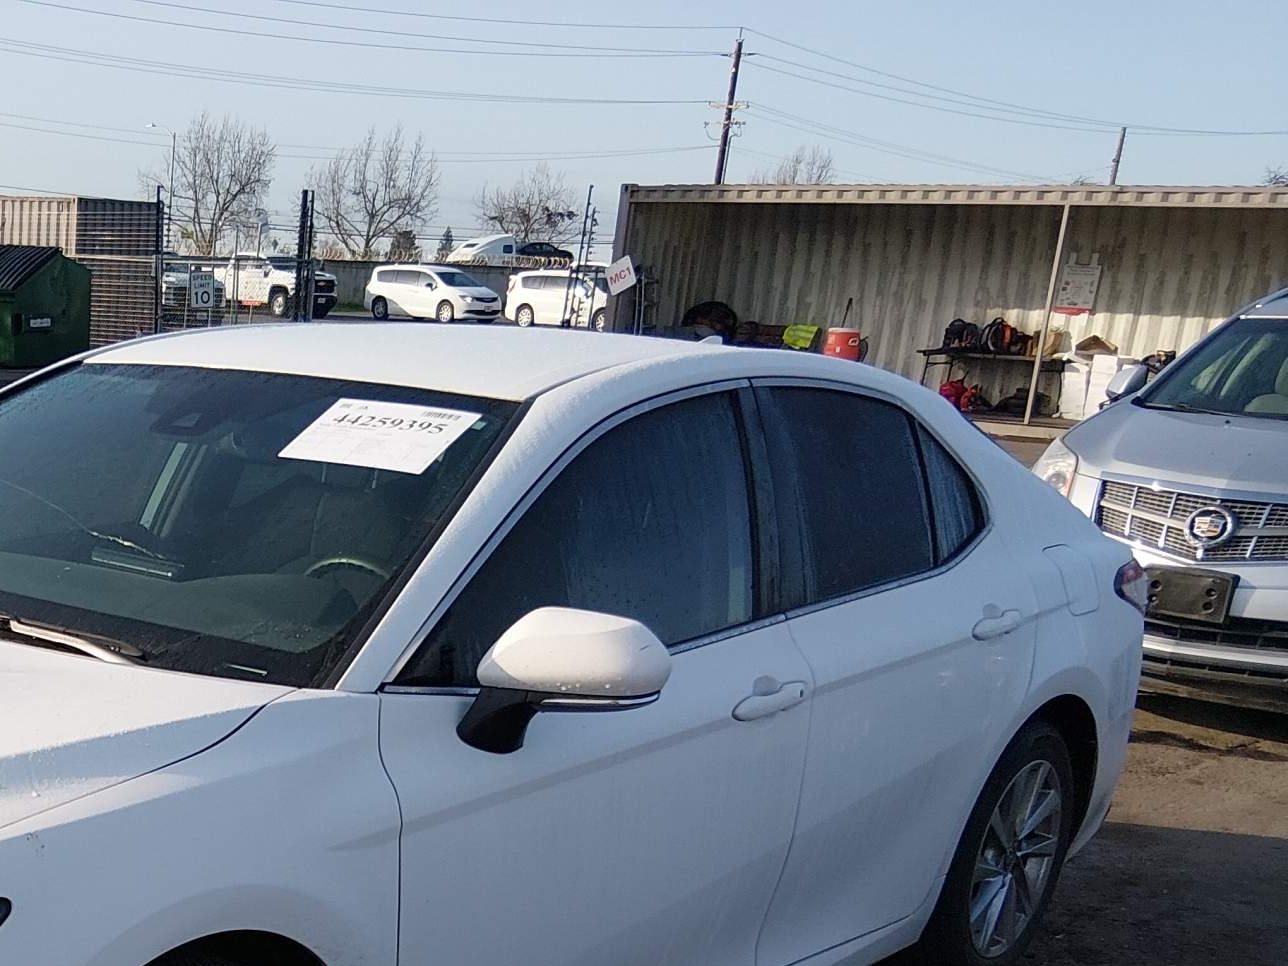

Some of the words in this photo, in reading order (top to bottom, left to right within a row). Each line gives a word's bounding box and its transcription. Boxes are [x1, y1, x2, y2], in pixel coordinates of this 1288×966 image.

[609, 267, 631, 286] MC1
[194, 291, 210, 305] 10
[334, 413, 448, 435] 44259395
